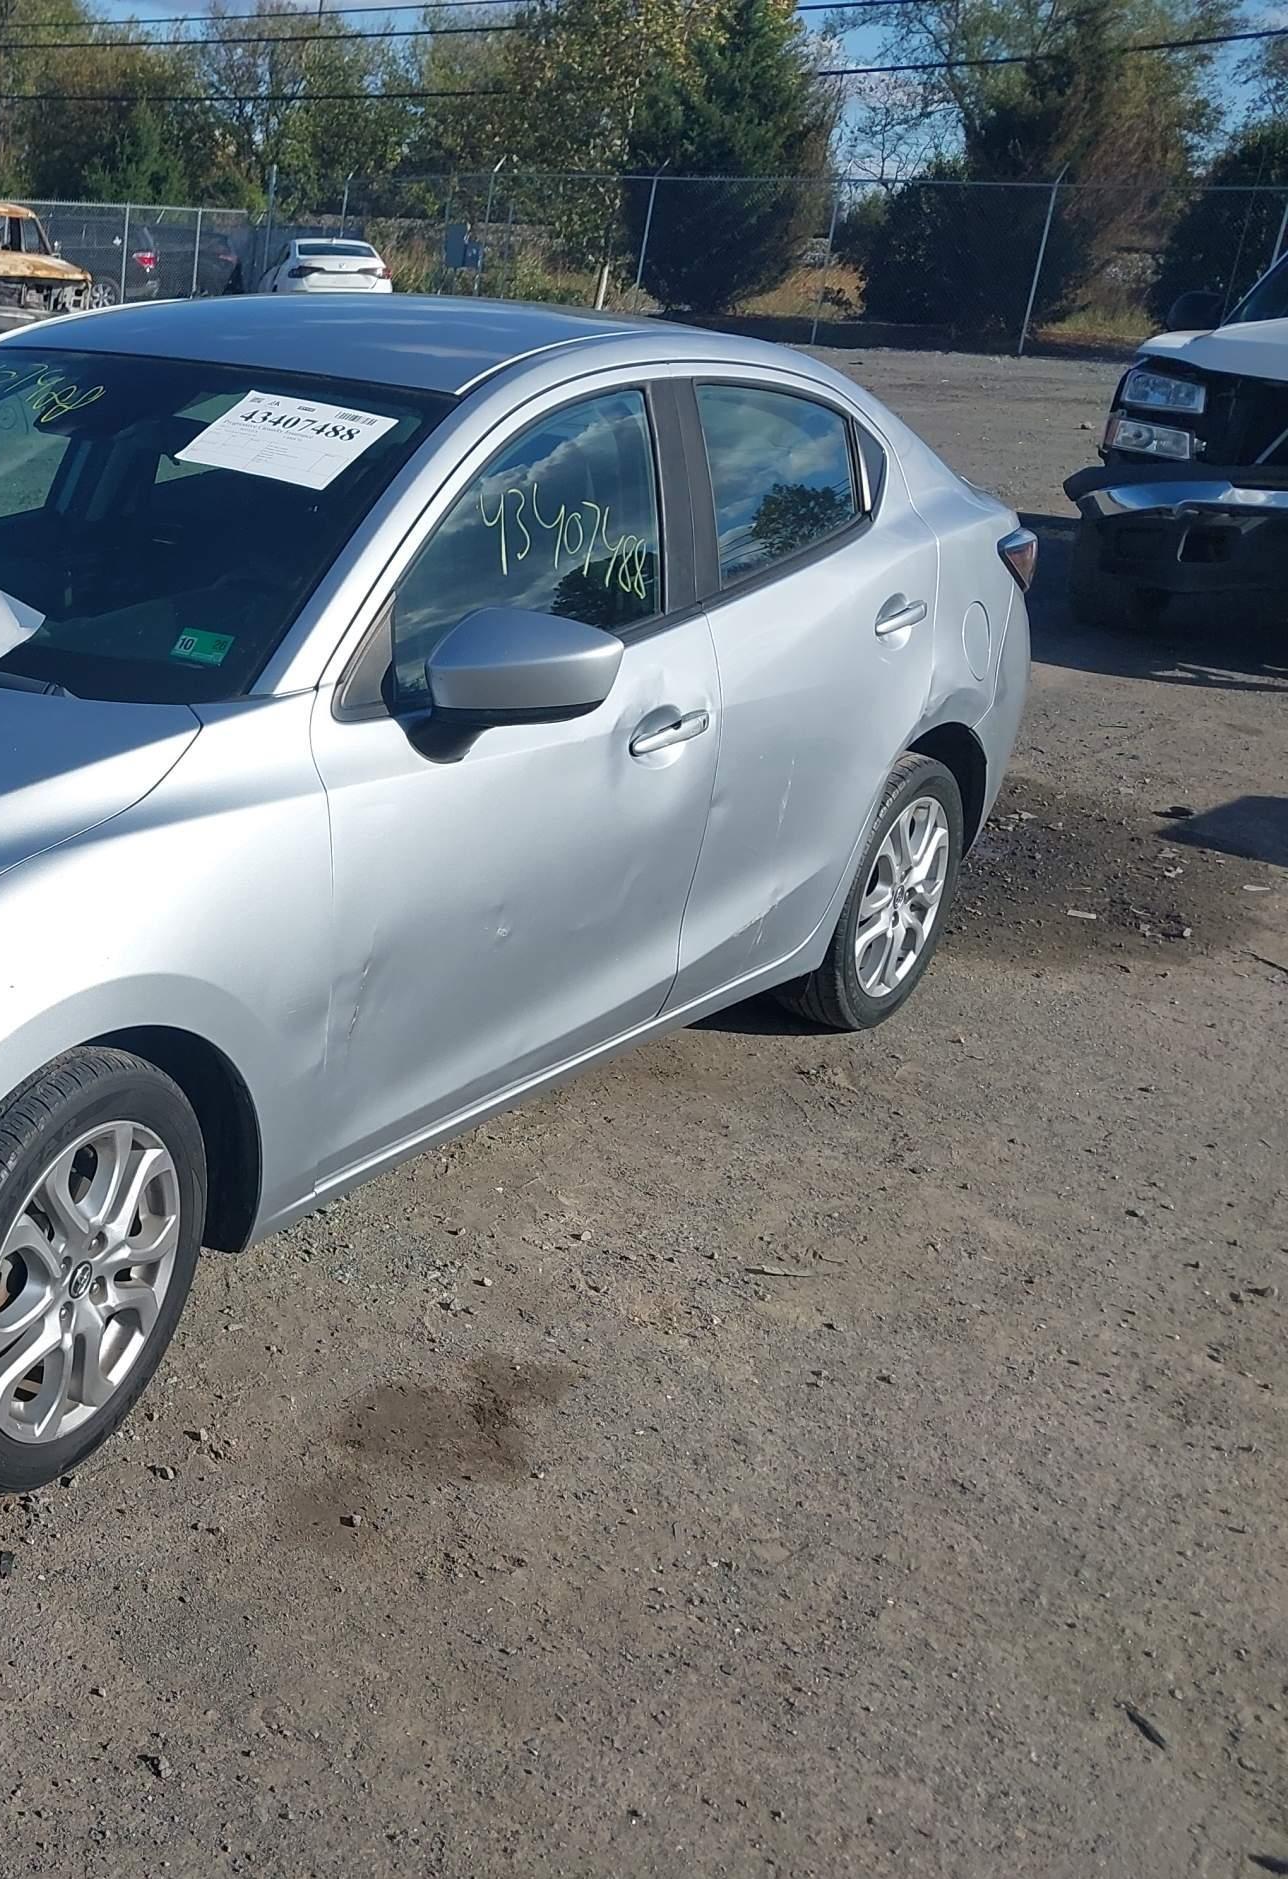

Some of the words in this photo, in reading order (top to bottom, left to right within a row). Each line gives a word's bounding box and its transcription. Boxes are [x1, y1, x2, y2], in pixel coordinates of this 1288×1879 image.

[239, 409, 361, 442] 43407488
[480, 482, 648, 600] 43407488
[178, 636, 196, 651] 10
